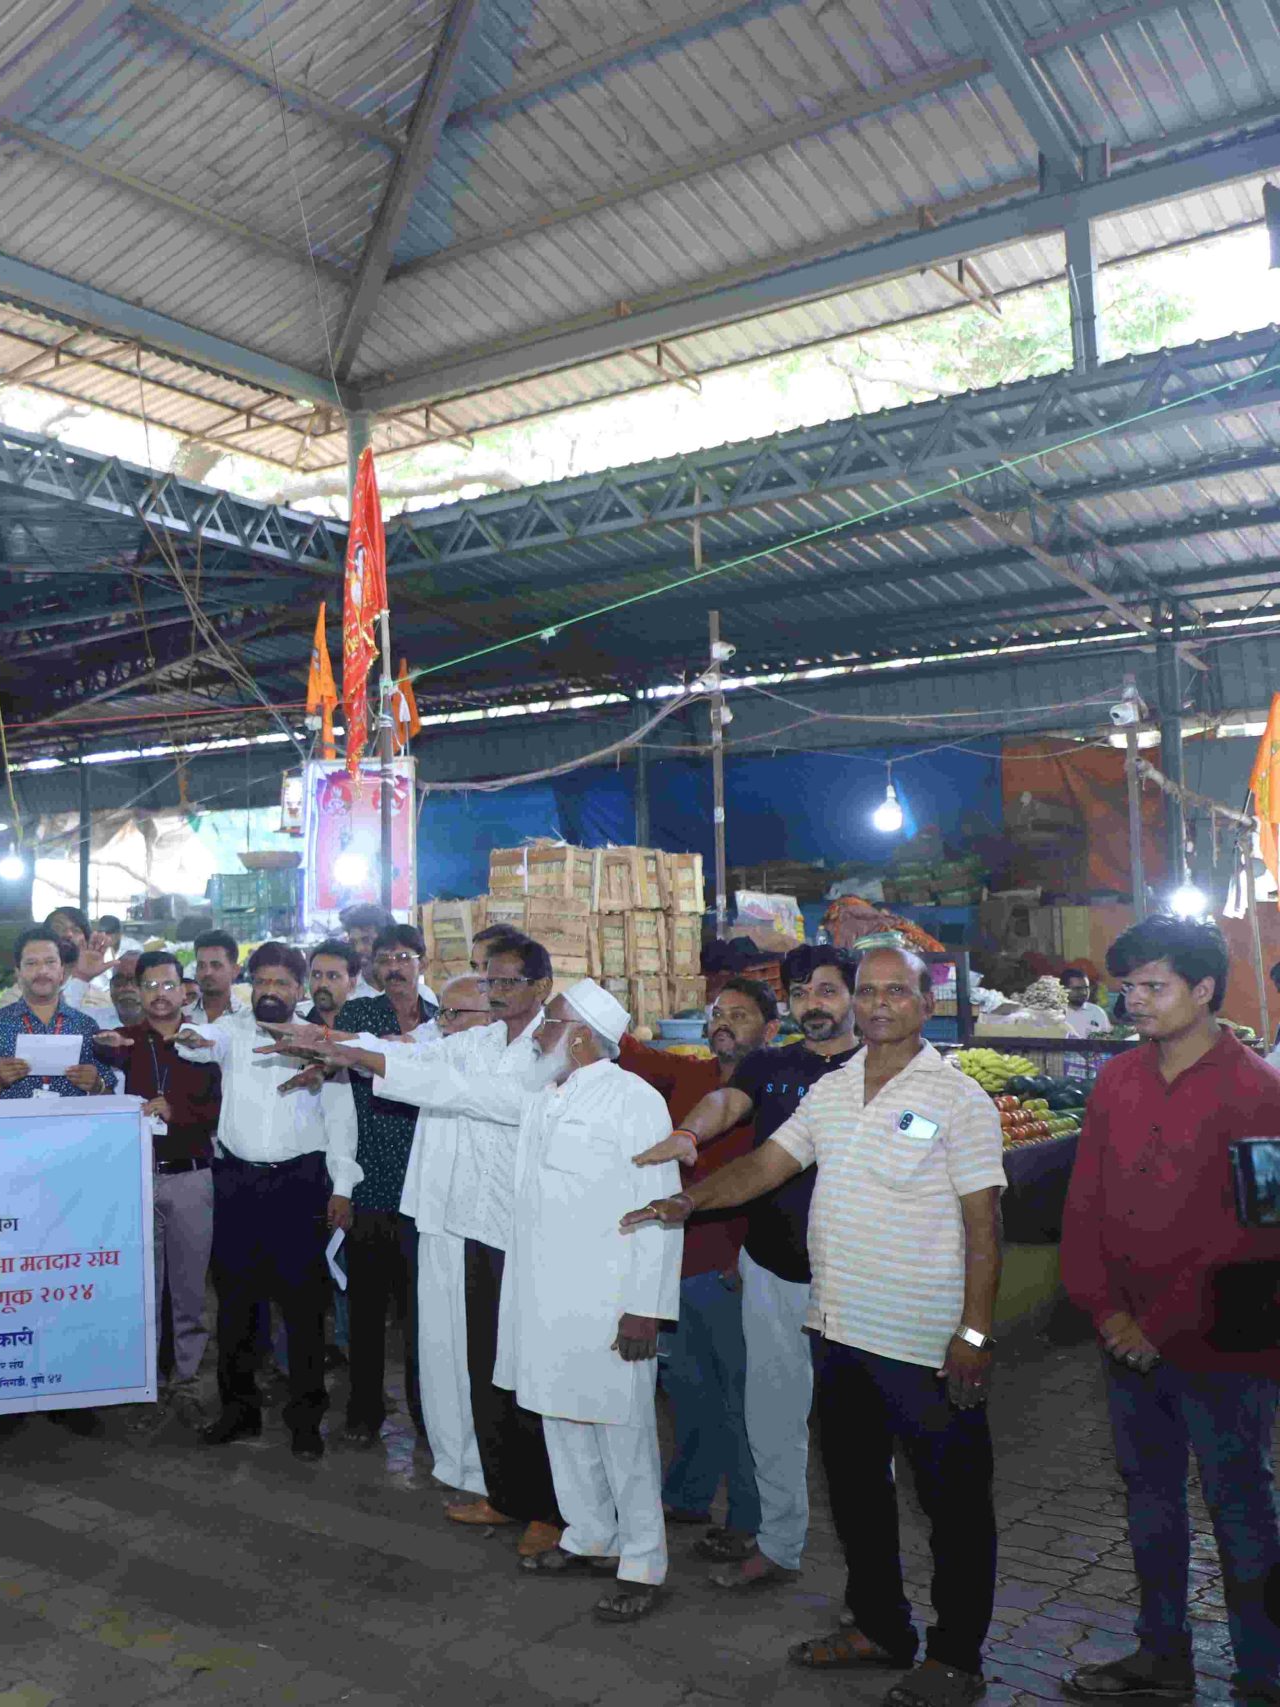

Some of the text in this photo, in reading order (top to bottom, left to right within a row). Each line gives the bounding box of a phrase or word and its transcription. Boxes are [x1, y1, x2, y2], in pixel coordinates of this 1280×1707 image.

[20, 1253, 82, 1272] मतदार
[87, 1246, 121, 1267] संघ
[40, 1283, 94, 1303] २०२४
